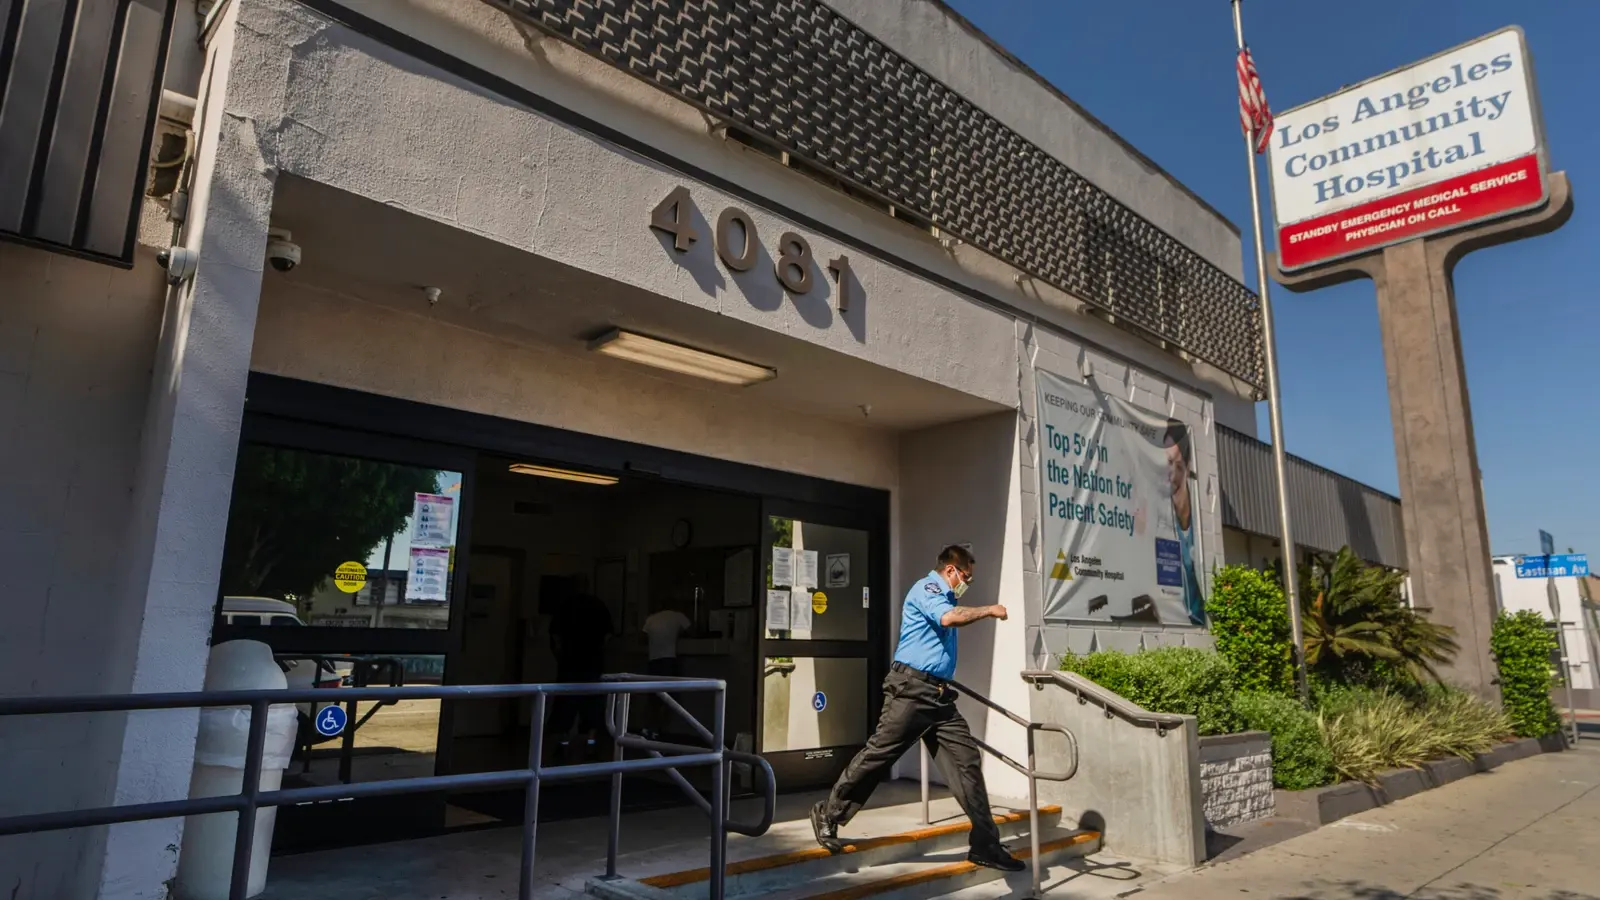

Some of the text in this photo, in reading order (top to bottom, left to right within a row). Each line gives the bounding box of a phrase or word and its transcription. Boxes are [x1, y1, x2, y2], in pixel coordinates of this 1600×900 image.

[1278, 53, 1512, 149] Los Angeles
[1284, 90, 1513, 178] Community
[1313, 131, 1486, 205] Hospital
[1290, 169, 1528, 244] STANDBY EMERGENCY MEDICAL SERVICE
[1345, 203, 1461, 243] PHYSICIAN ON CALL
[649, 184, 850, 312] 4081
[1044, 393, 1080, 413] KEEPING
[1079, 404, 1096, 417] OUR
[1046, 424, 1108, 463] Top 5% in
[1047, 459, 1133, 500] the Nation for
[1049, 491, 1136, 537] Patient Safety
[336, 573, 365, 581] CAUTION
[1070, 554, 1080, 563] Los
[1074, 566, 1125, 582] Community Hospital
[1518, 564, 1586, 577] Eastman Av
